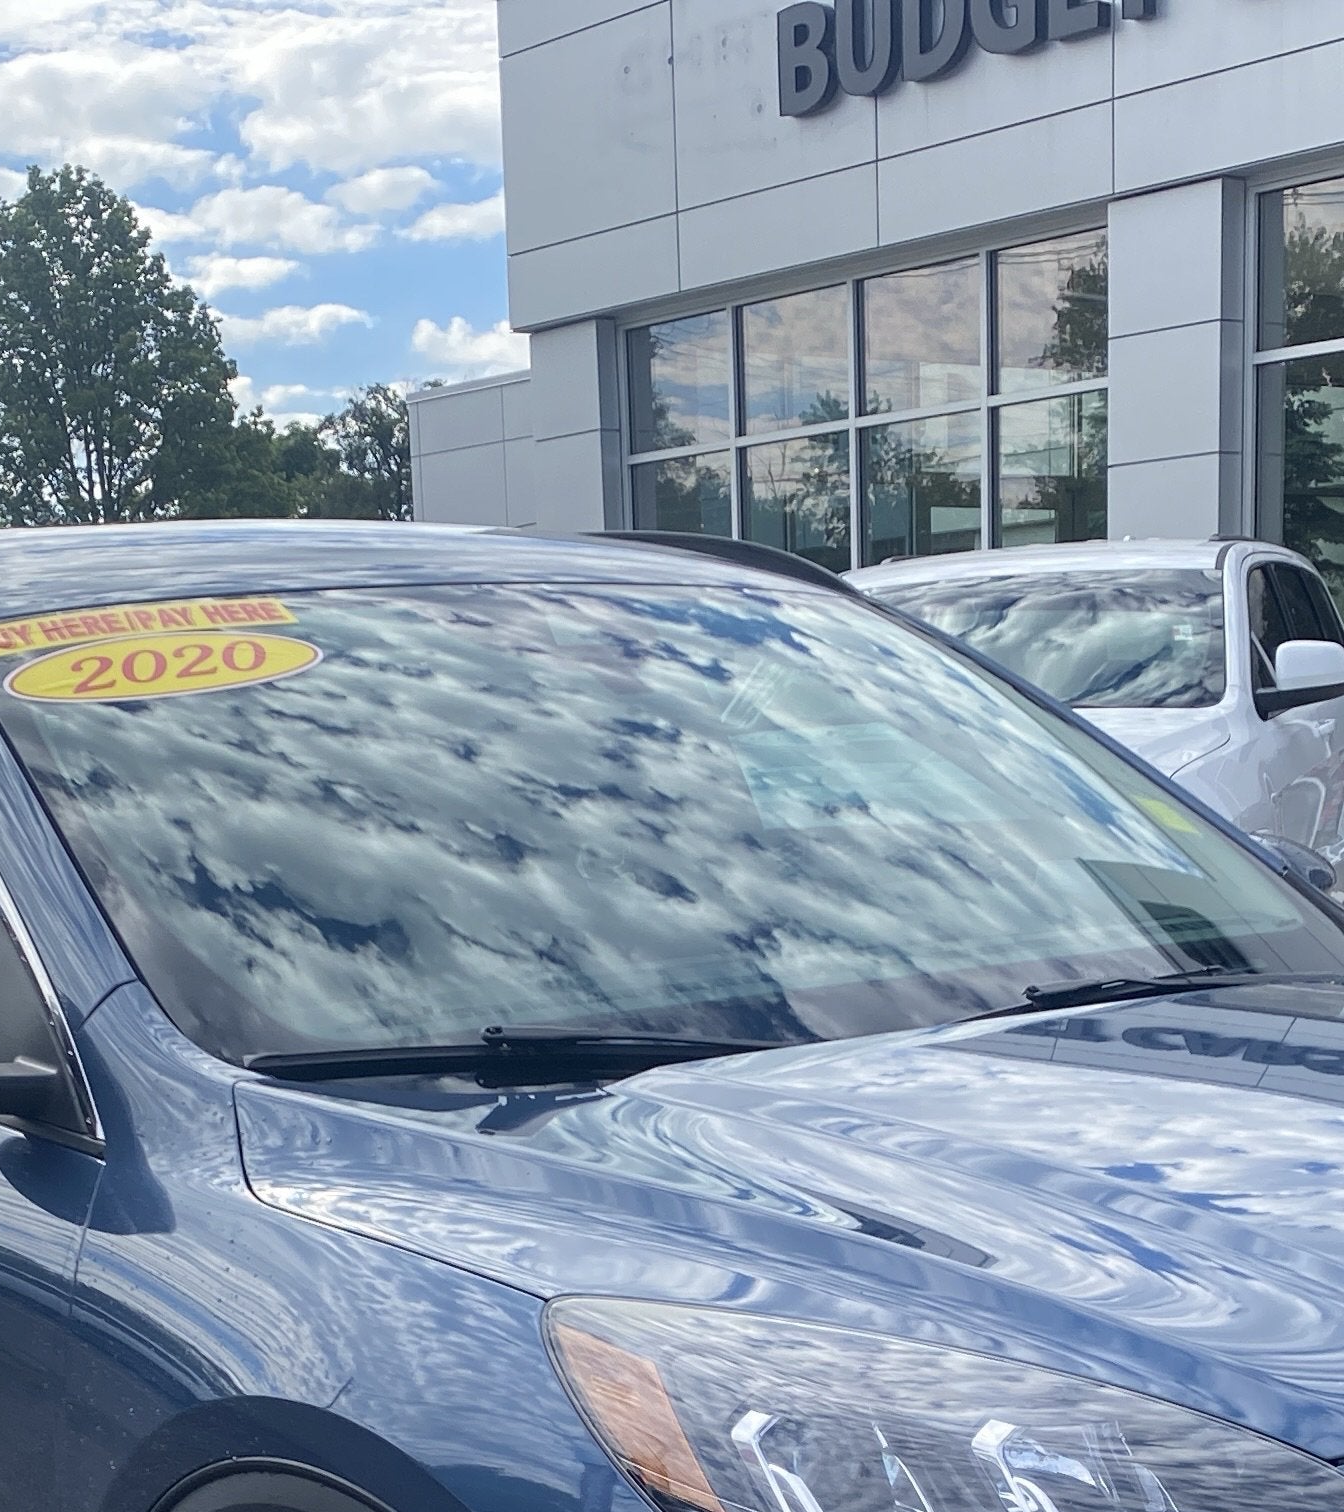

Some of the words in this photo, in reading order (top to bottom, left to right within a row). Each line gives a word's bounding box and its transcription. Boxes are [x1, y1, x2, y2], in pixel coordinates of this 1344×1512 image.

[777, 0, 1156, 117] BUDG
[199, 601, 286, 624] HERE
[71, 640, 267, 694] 2020
